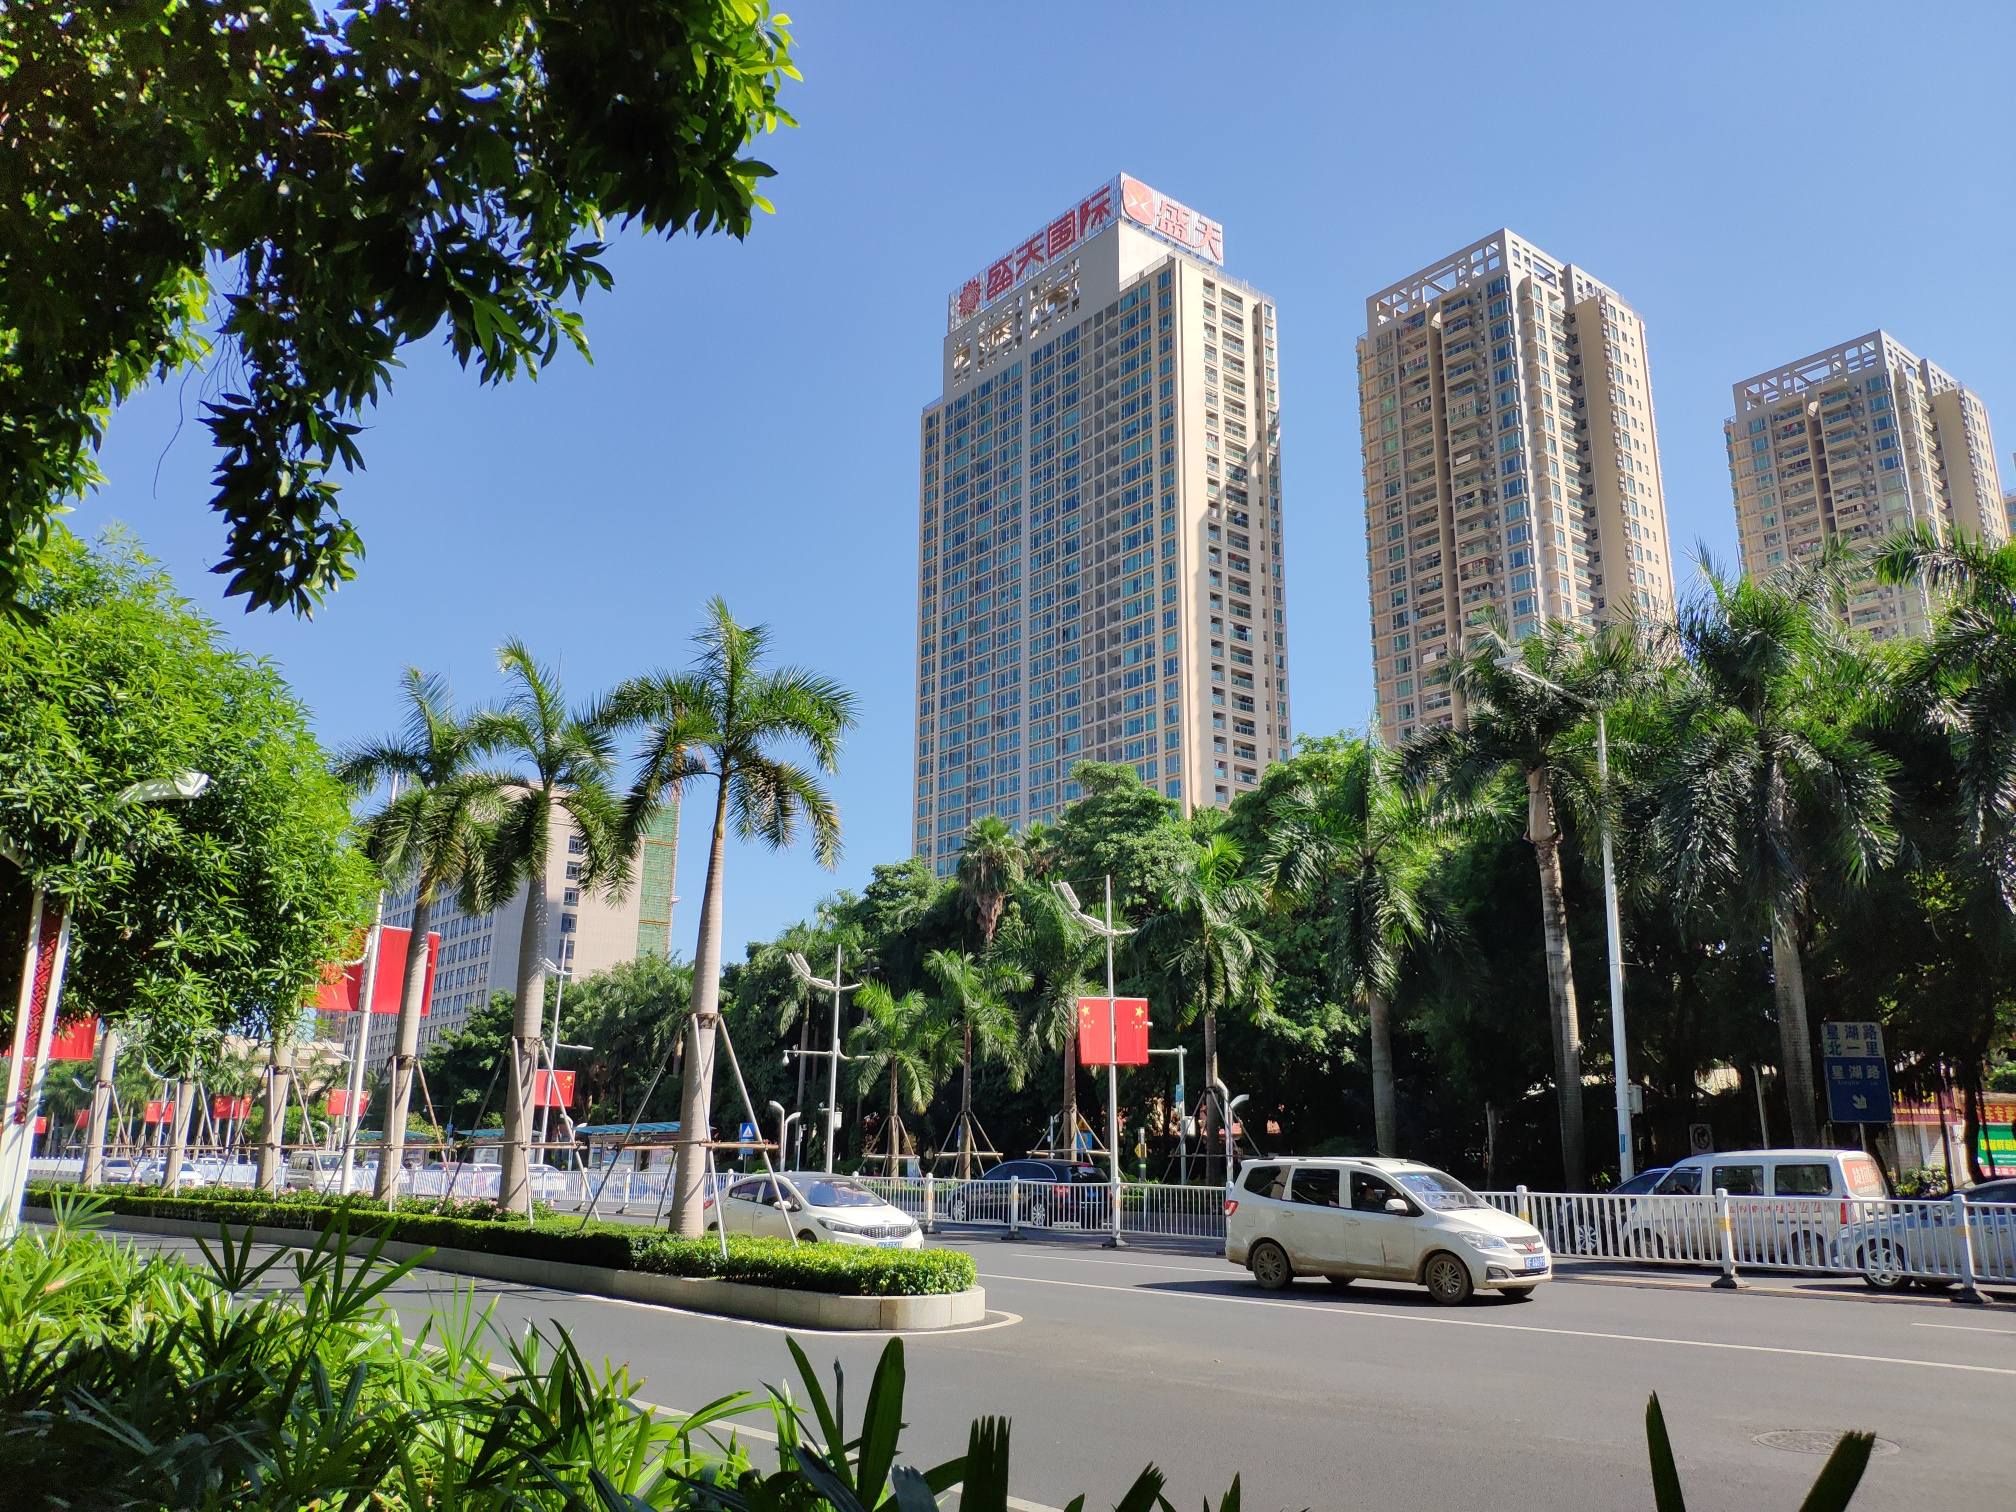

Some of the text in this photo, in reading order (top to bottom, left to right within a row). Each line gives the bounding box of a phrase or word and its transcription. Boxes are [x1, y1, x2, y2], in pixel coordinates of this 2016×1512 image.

[1156, 200, 1222, 261] 盛天
[986, 186, 1111, 301] 盛天国际
[1827, 1024, 1877, 1040] 星湖路
[1827, 1040, 1880, 1056] 北一里
[1831, 1065, 1880, 1080] 星湖路
